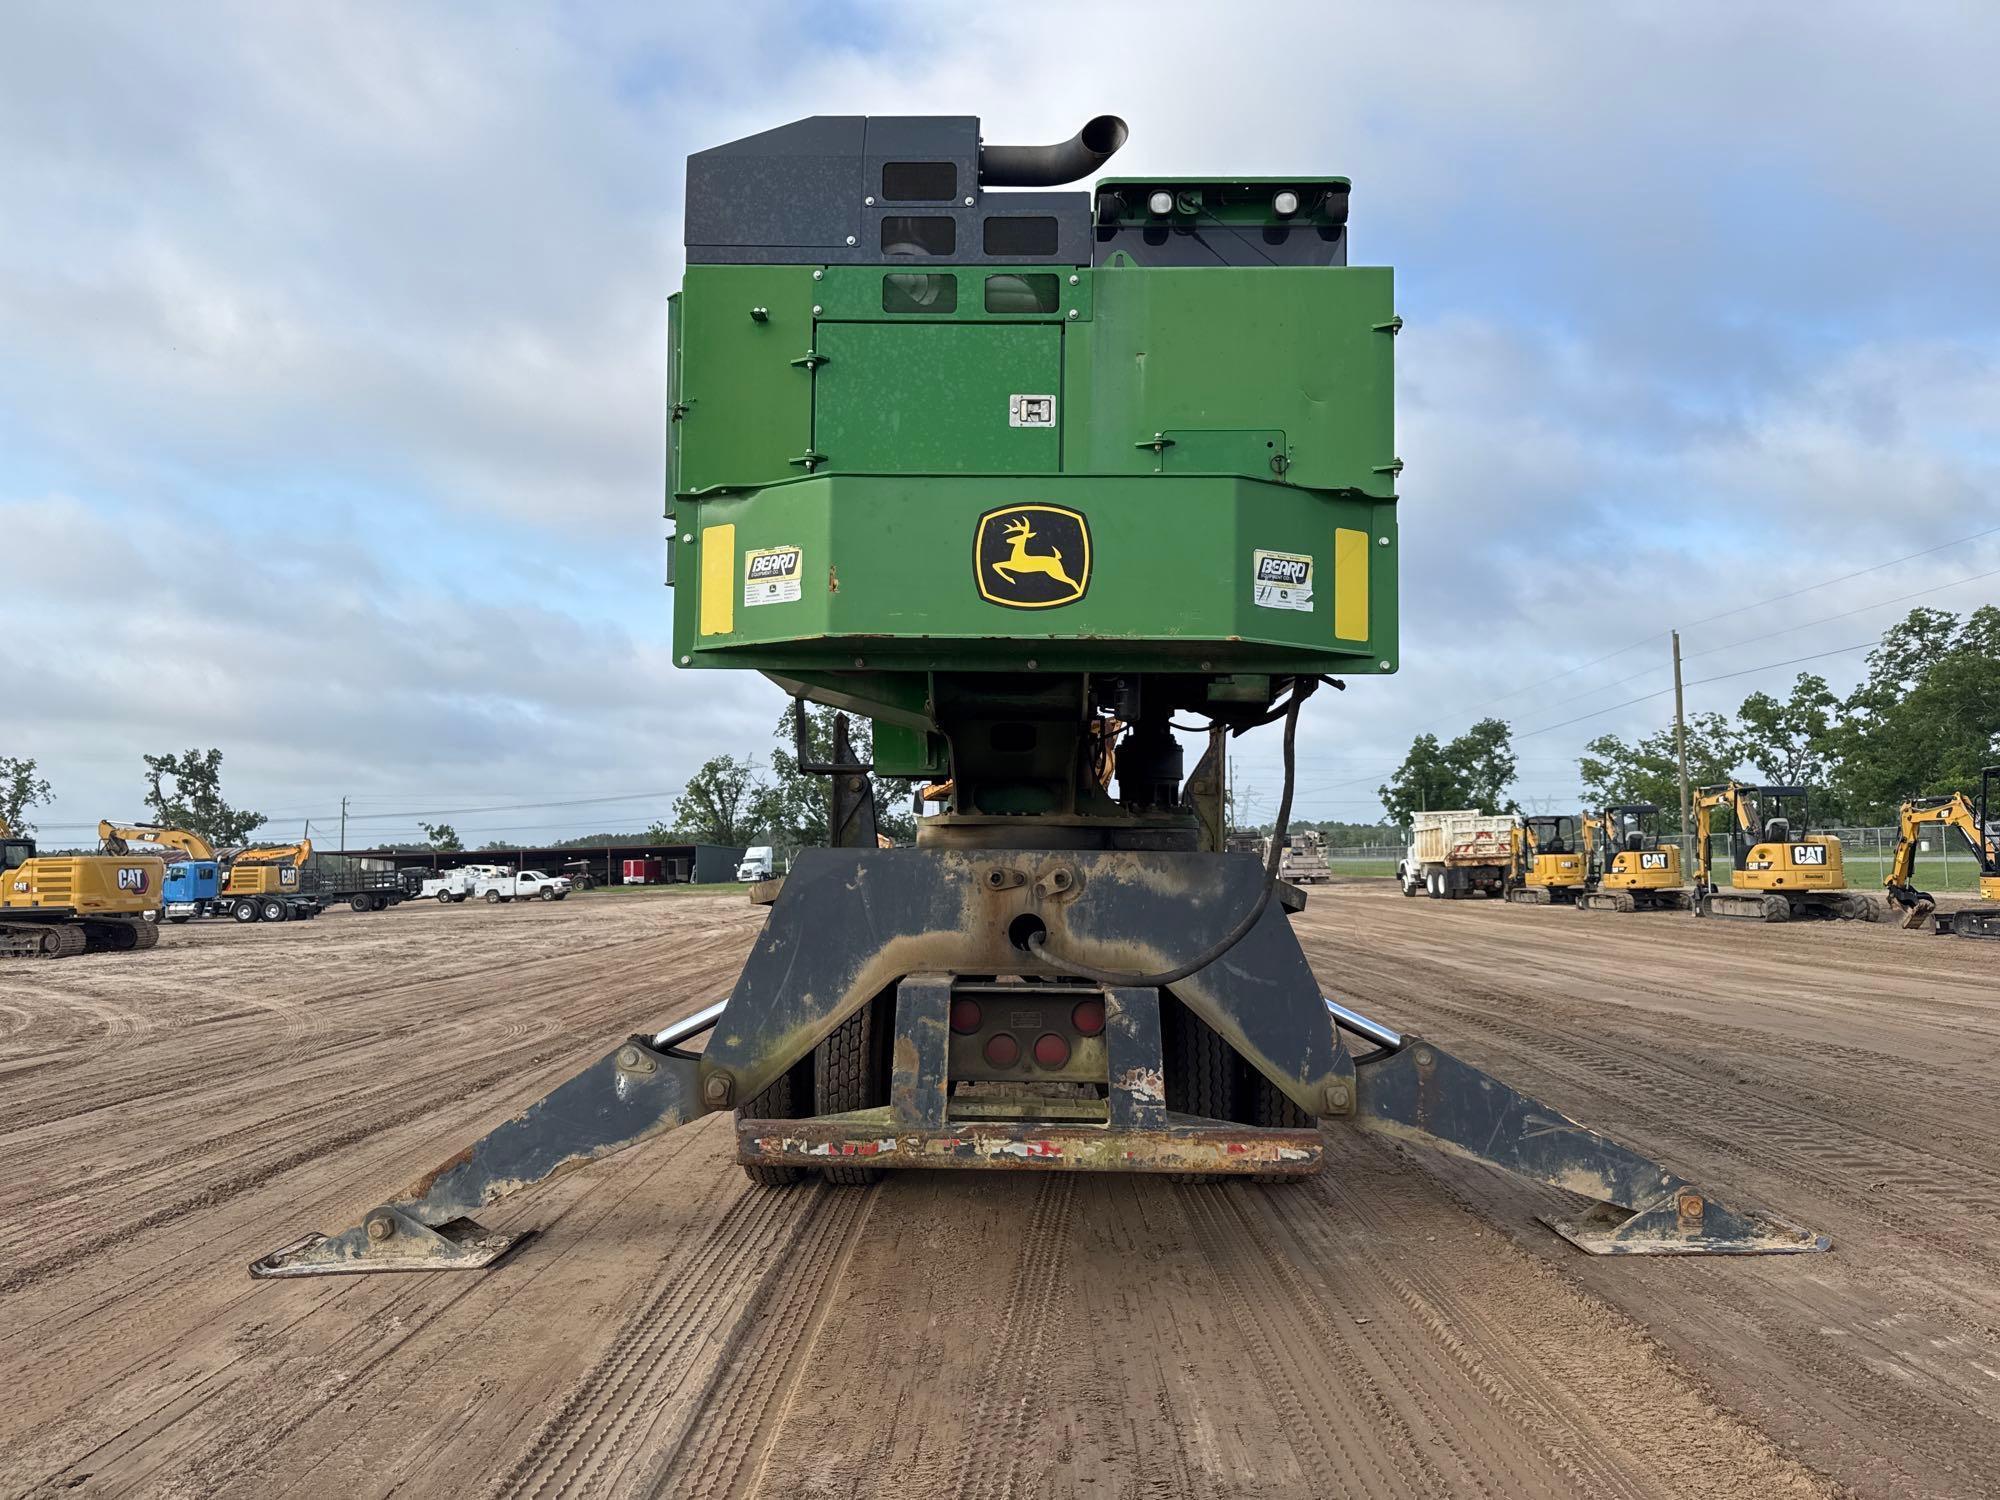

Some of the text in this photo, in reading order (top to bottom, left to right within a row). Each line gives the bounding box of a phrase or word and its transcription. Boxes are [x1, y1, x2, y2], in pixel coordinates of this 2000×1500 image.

[752, 553, 795, 576] BEARD
[1262, 559, 1306, 584] BEARD
[1642, 854, 1666, 869] CAT
[1794, 846, 1823, 864] CAT
[118, 869, 142, 889] CAT
[281, 869, 296, 884] CAT
[14, 882, 28, 891] CAT
